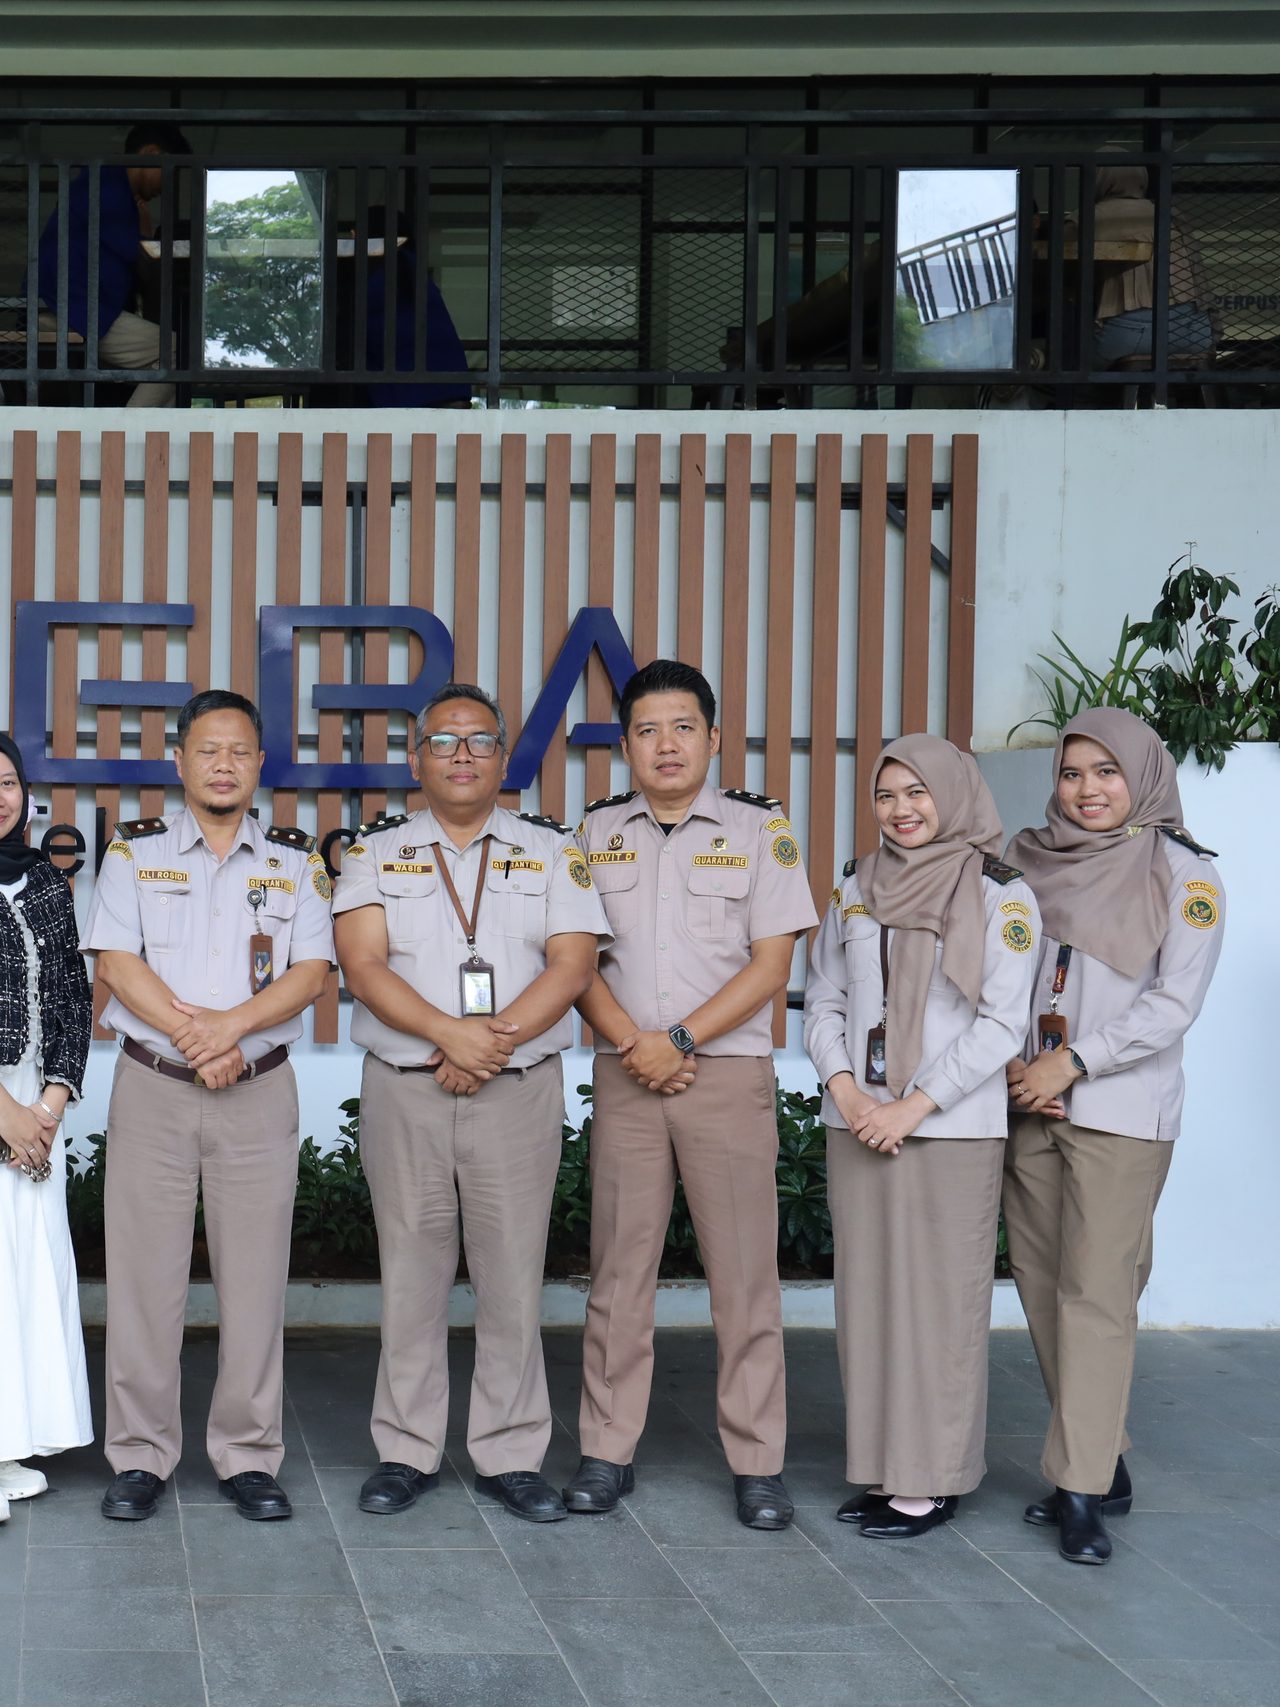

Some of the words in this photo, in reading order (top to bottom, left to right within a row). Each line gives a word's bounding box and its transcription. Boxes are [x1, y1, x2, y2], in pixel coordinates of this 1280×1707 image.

[592, 853, 622, 862] DAVIT
[626, 853, 632, 861] D
[695, 856, 746, 866] QUARANTINE
[493, 861, 542, 870] QURANTINE
[140, 871, 154, 879] ALI
